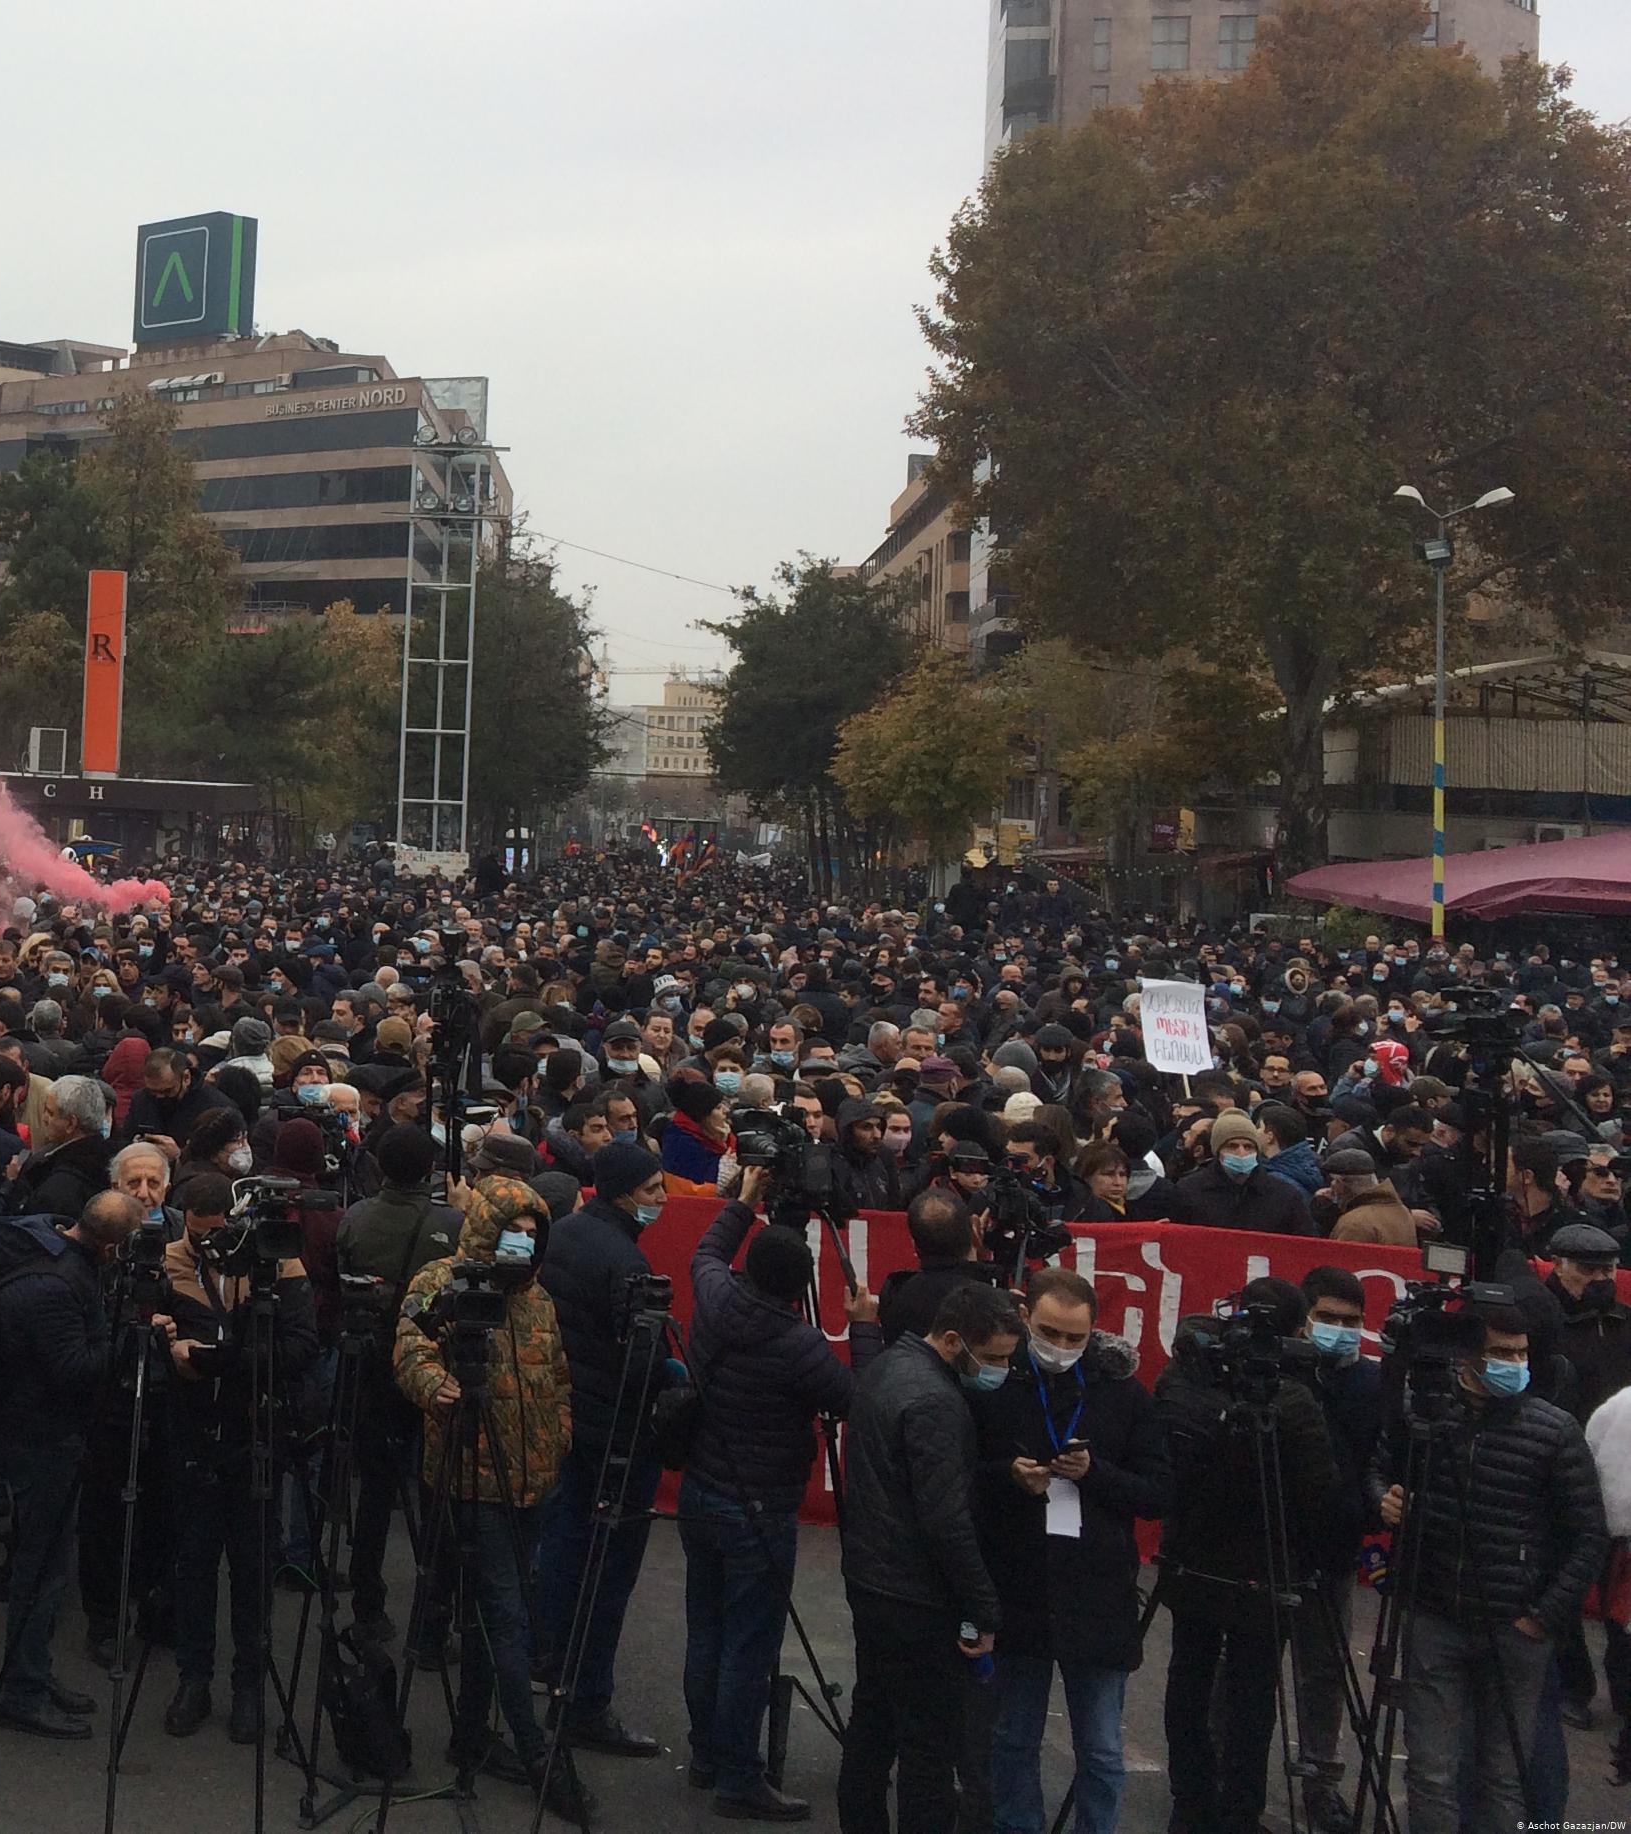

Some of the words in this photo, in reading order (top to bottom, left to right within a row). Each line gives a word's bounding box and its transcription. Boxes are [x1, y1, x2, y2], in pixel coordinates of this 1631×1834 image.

[265, 402, 314, 417] BUSINESS
[315, 397, 357, 412] CENTER
[359, 387, 407, 408] NORD
[91, 633, 117, 662] R
